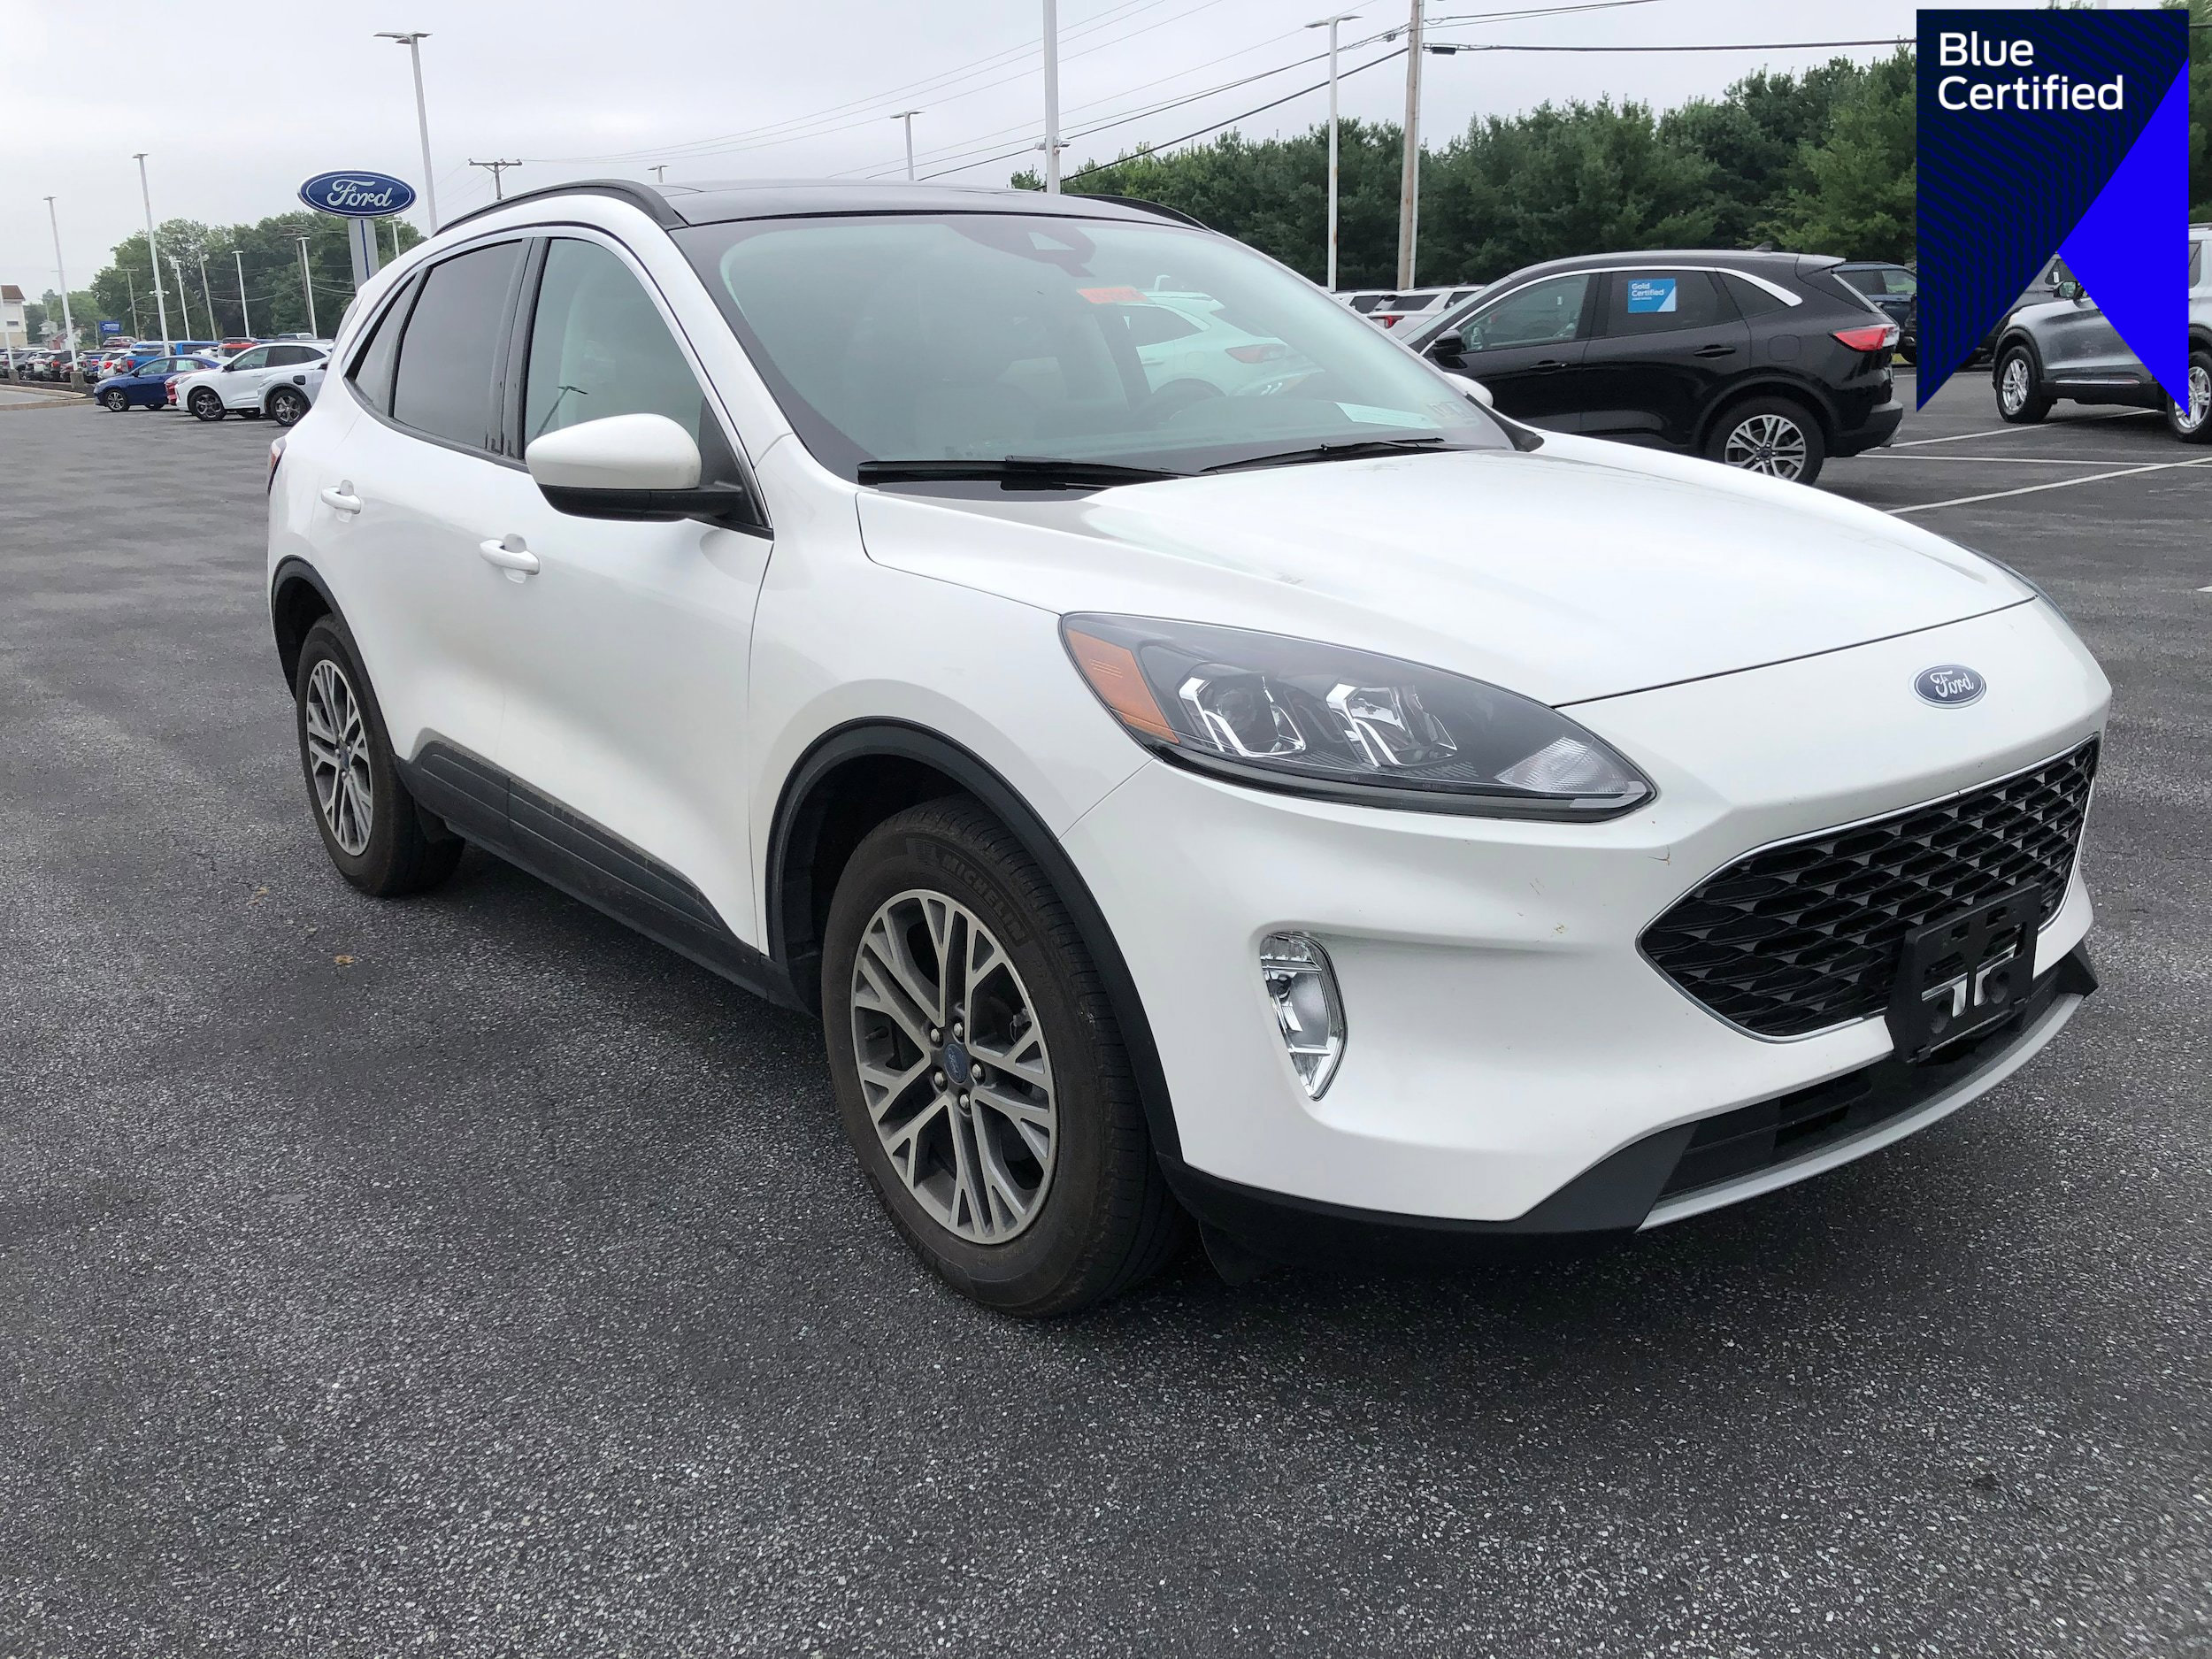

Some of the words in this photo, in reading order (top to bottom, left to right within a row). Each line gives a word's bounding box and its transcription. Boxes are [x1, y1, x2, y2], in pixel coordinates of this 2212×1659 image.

[326, 179, 393, 207] Ford
[1930, 670, 1974, 698] Ford
[941, 855, 1025, 941] MICHELIN
